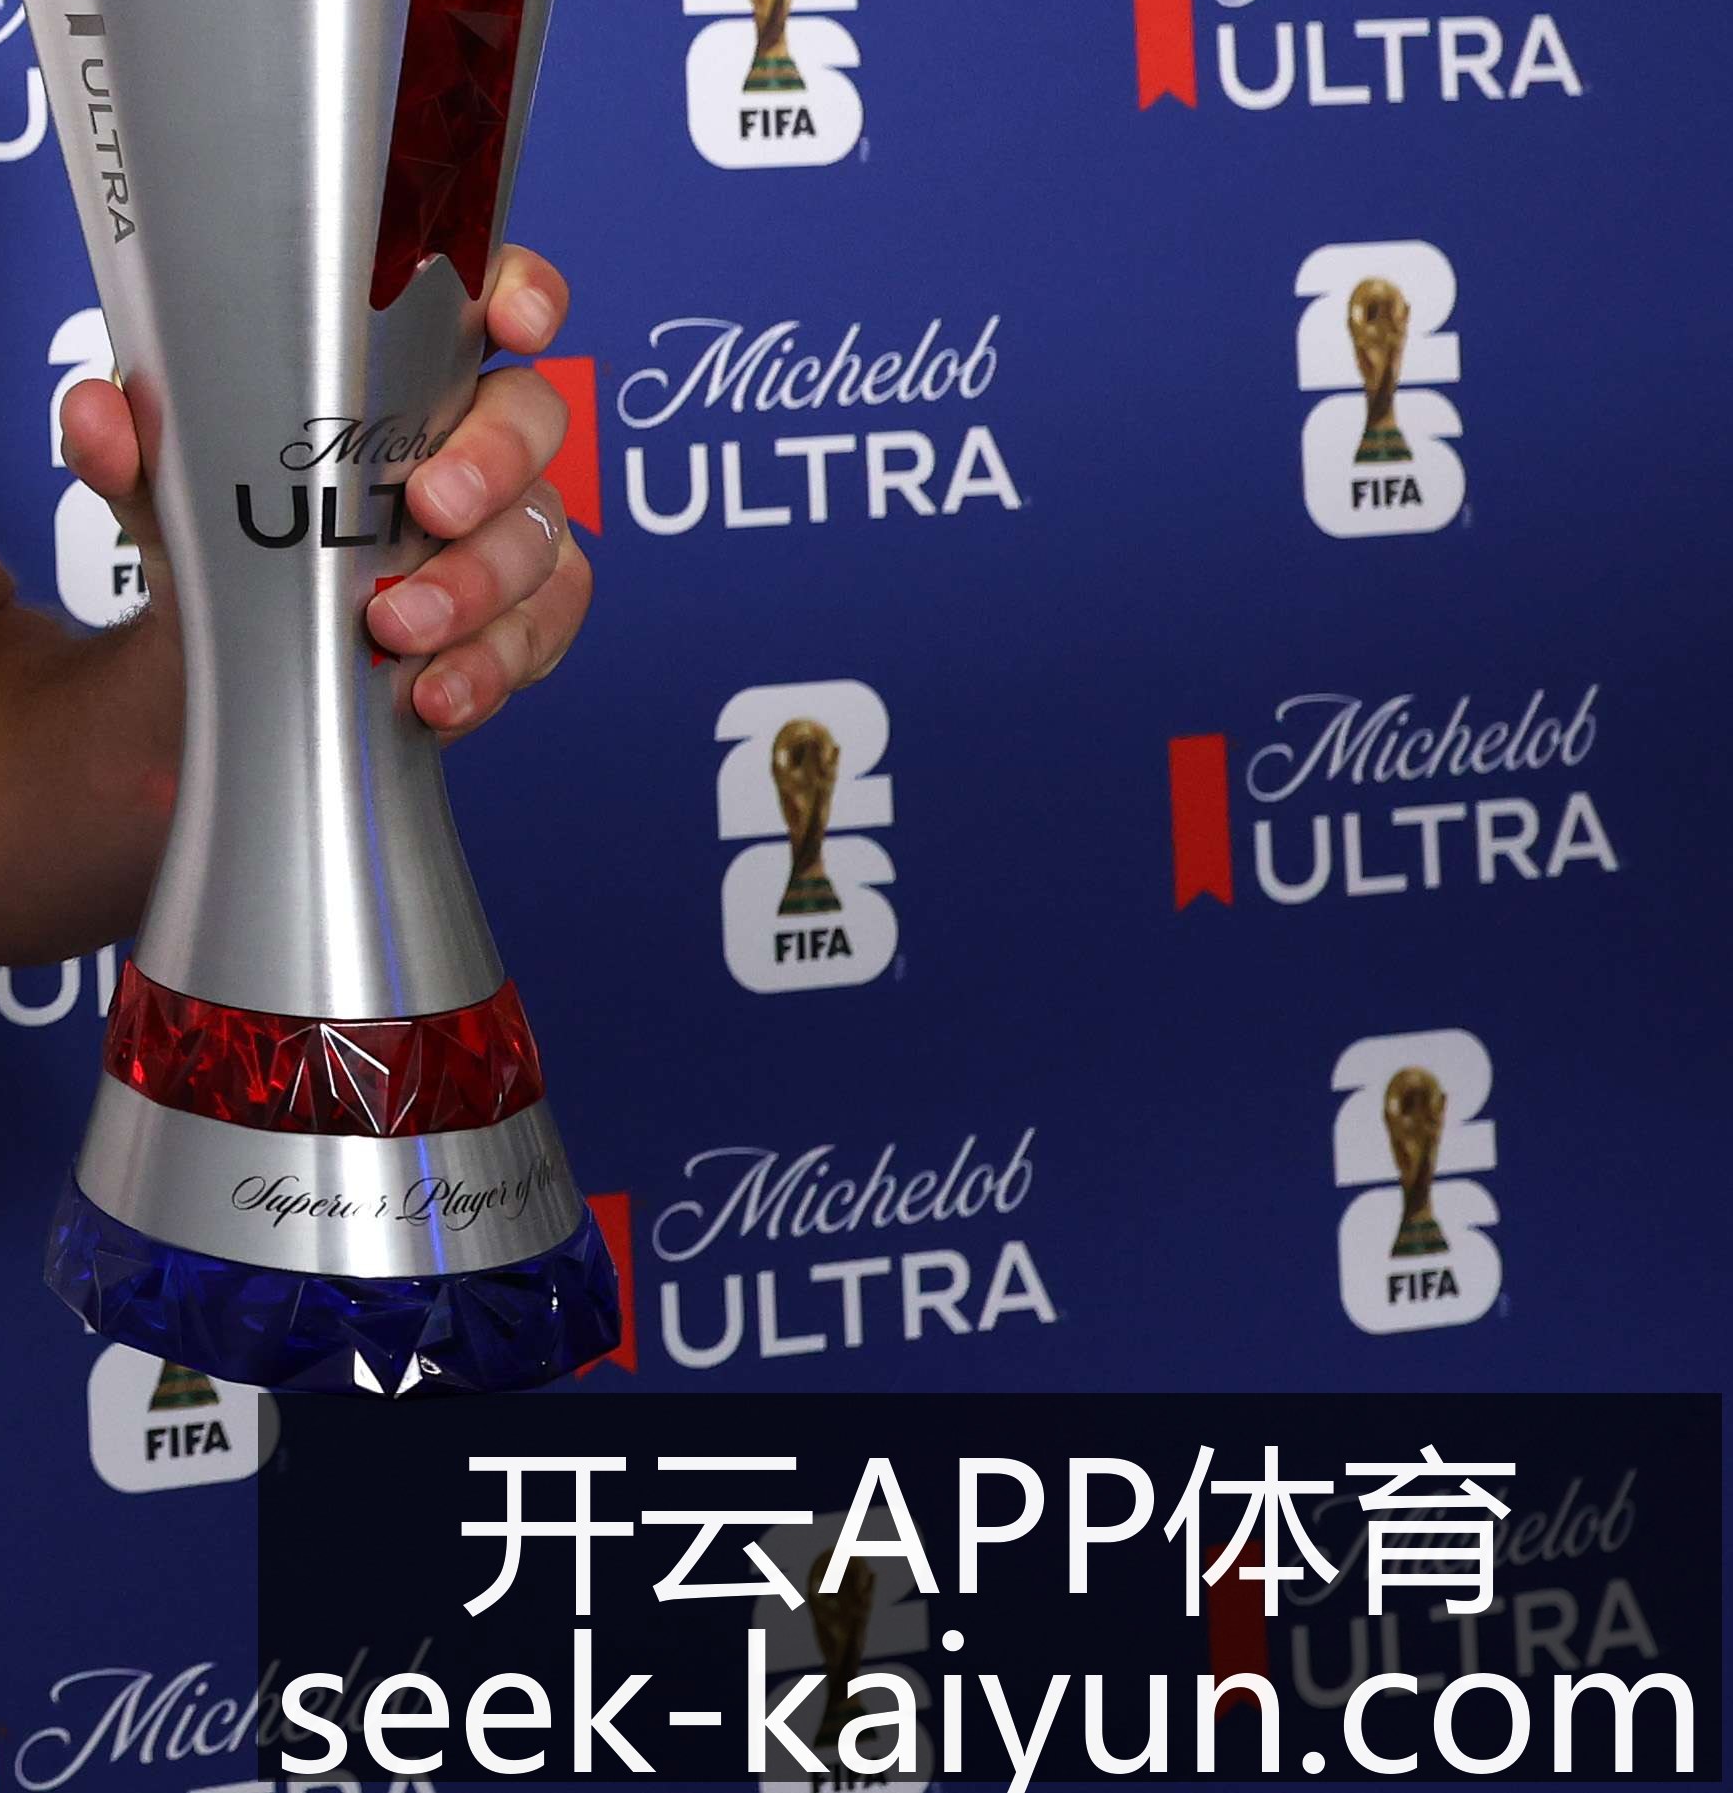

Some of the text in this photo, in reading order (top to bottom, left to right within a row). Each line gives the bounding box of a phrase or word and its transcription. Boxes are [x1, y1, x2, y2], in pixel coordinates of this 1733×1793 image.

[1217, 15, 1581, 109] ULTRA
[81, 59, 135, 244] ULTRA
[739, 108, 816, 138] FIFA
[618, 315, 999, 428] Michelob
[236, 481, 406, 549] ULT
[626, 426, 1021, 534] ULTRA
[1351, 478, 1422, 508] FIFA
[1248, 685, 1597, 801] Michelob
[1255, 793, 1617, 903] ULTRA
[774, 928, 852, 963] FIFA
[395, 1177, 508, 1231] Player
[654, 1128, 1034, 1261] Michelob
[661, 1241, 1056, 1368] ULTRA
[1388, 1269, 1459, 1300] FIFA
[146, 1421, 231, 1461] FIFA
